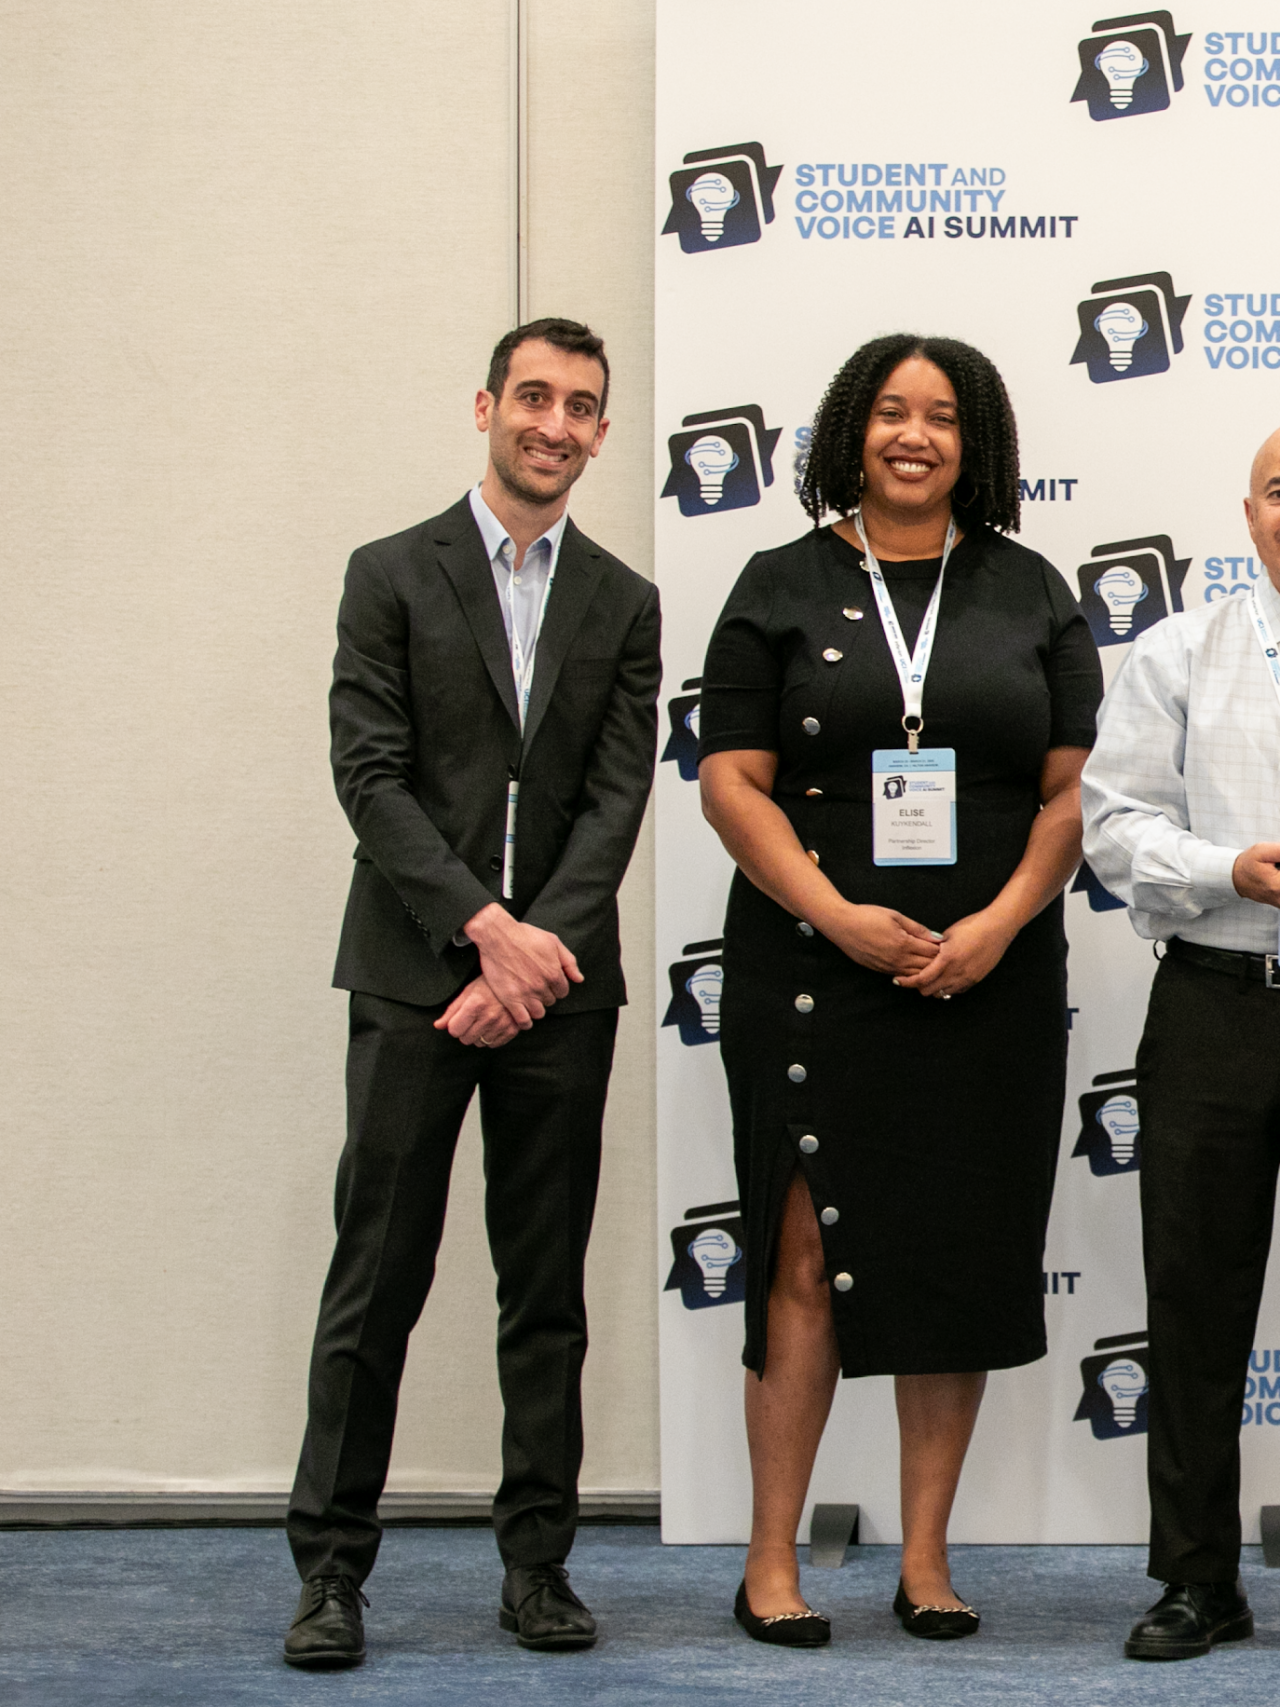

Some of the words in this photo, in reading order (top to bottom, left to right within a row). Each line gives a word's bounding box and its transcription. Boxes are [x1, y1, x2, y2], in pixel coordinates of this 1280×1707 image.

[795, 164, 948, 187] STUDENT
[951, 168, 1005, 186] AND
[795, 190, 1005, 213] COMMUNITY
[795, 216, 895, 239] VOICE
[903, 216, 934, 238] AI
[944, 216, 1078, 239] SUMMIT
[1019, 479, 1078, 501] MIT
[899, 809, 925, 817] ELISE
